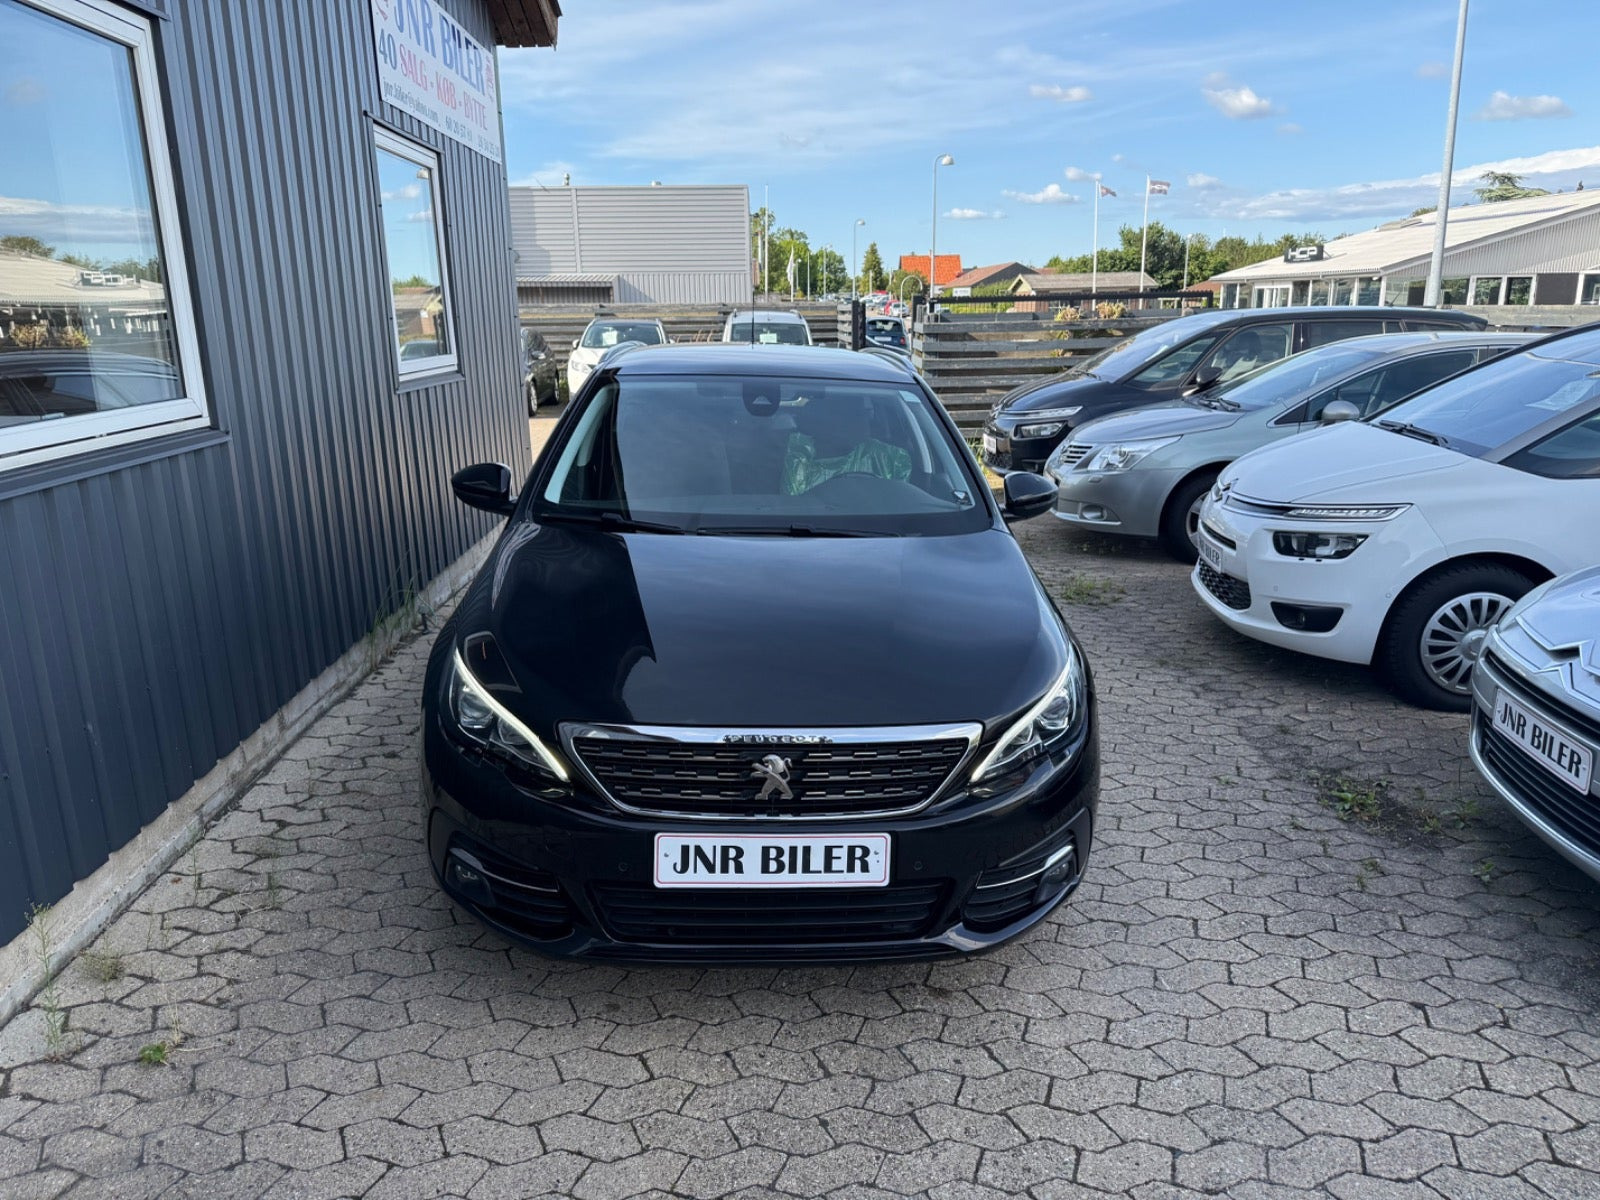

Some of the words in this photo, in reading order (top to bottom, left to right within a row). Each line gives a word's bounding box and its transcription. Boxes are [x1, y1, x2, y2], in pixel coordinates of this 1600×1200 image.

[394, 0, 436, 58] JNR
[439, 12, 485, 96] BILER
[400, 44, 428, 91] SALG
[463, 91, 488, 131] BYTTE
[728, 735, 818, 743] PEUGEOT
[1501, 703, 1527, 739] JNR
[1530, 723, 1582, 778] BILER
[673, 844, 744, 874] JNR
[760, 845, 870, 874] BILER
